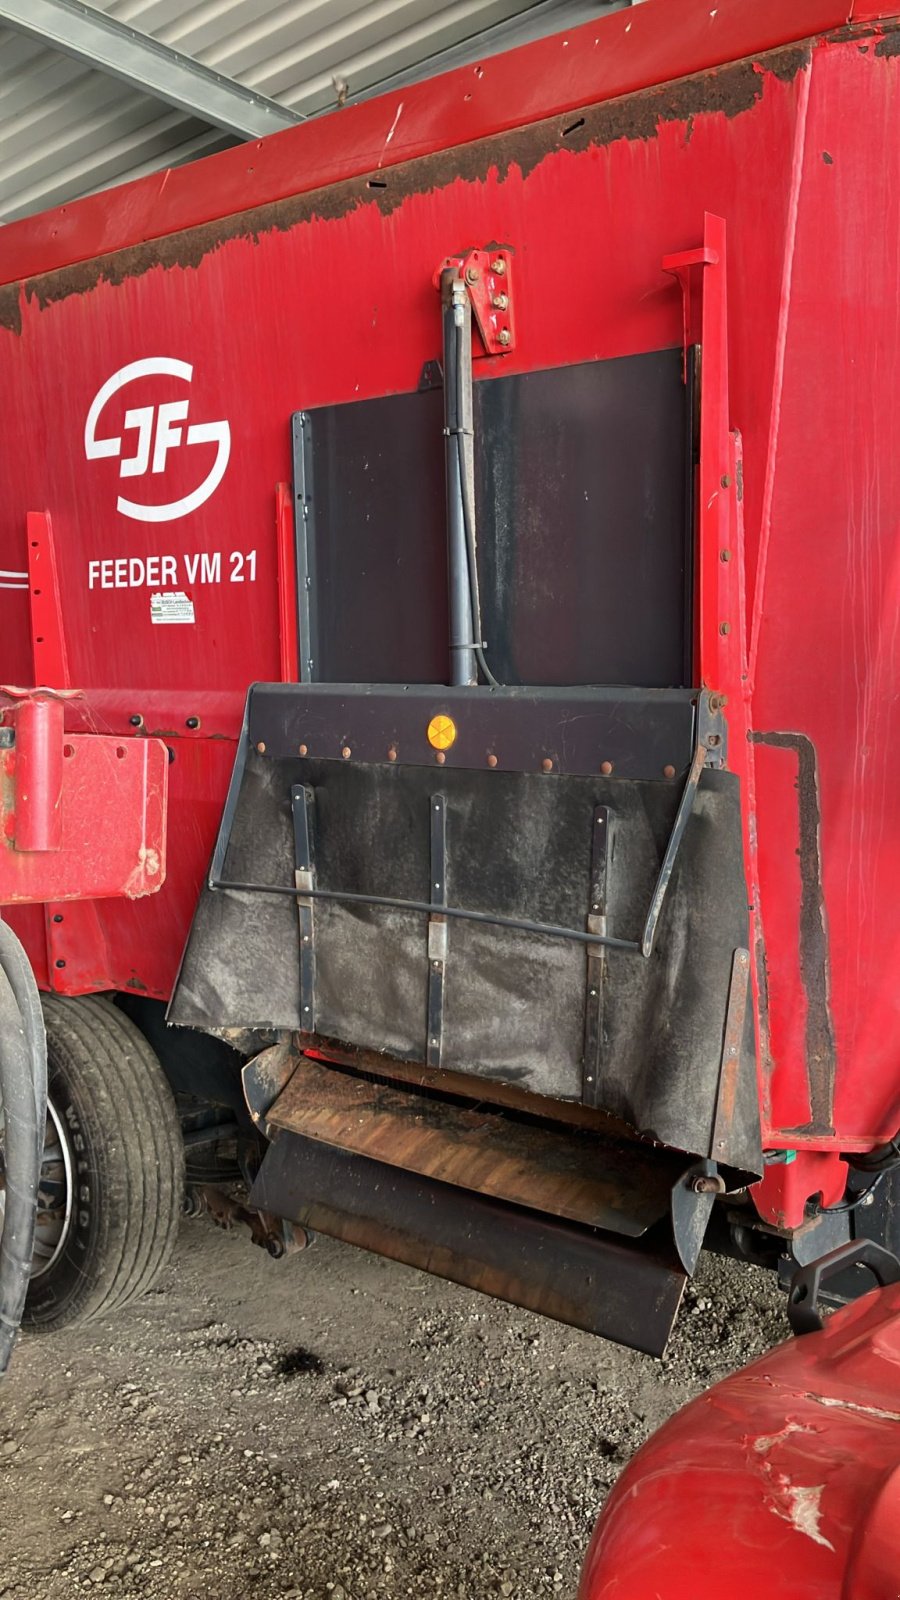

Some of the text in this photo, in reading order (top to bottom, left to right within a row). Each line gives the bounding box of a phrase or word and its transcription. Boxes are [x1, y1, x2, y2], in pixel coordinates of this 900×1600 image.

[119, 400, 190, 478] JF
[88, 549, 257, 590] FEEDER VM 21
